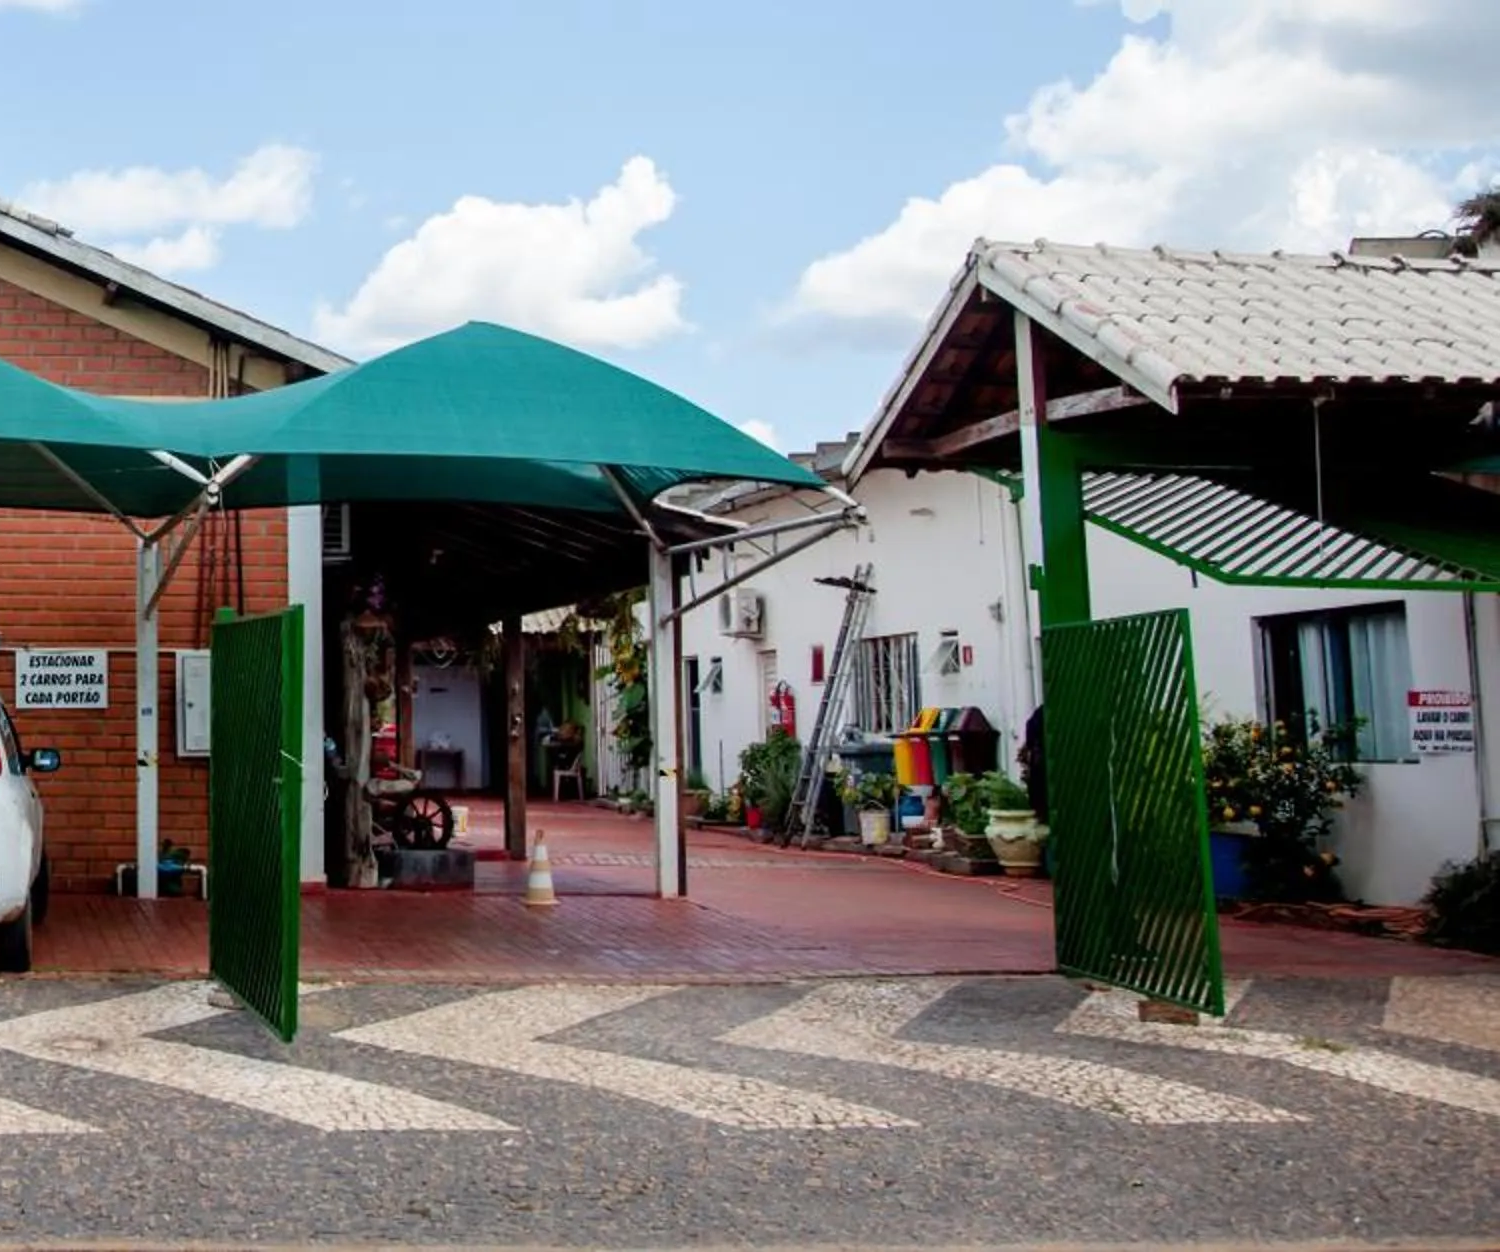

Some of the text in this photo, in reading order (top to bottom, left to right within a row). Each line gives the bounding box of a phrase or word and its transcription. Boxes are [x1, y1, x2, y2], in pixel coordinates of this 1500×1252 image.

[29, 655, 95, 668] ESTACIONAR
[20, 673, 104, 686] 2 CARROS PARA
[25, 689, 100, 705] CADA PORTÃO
